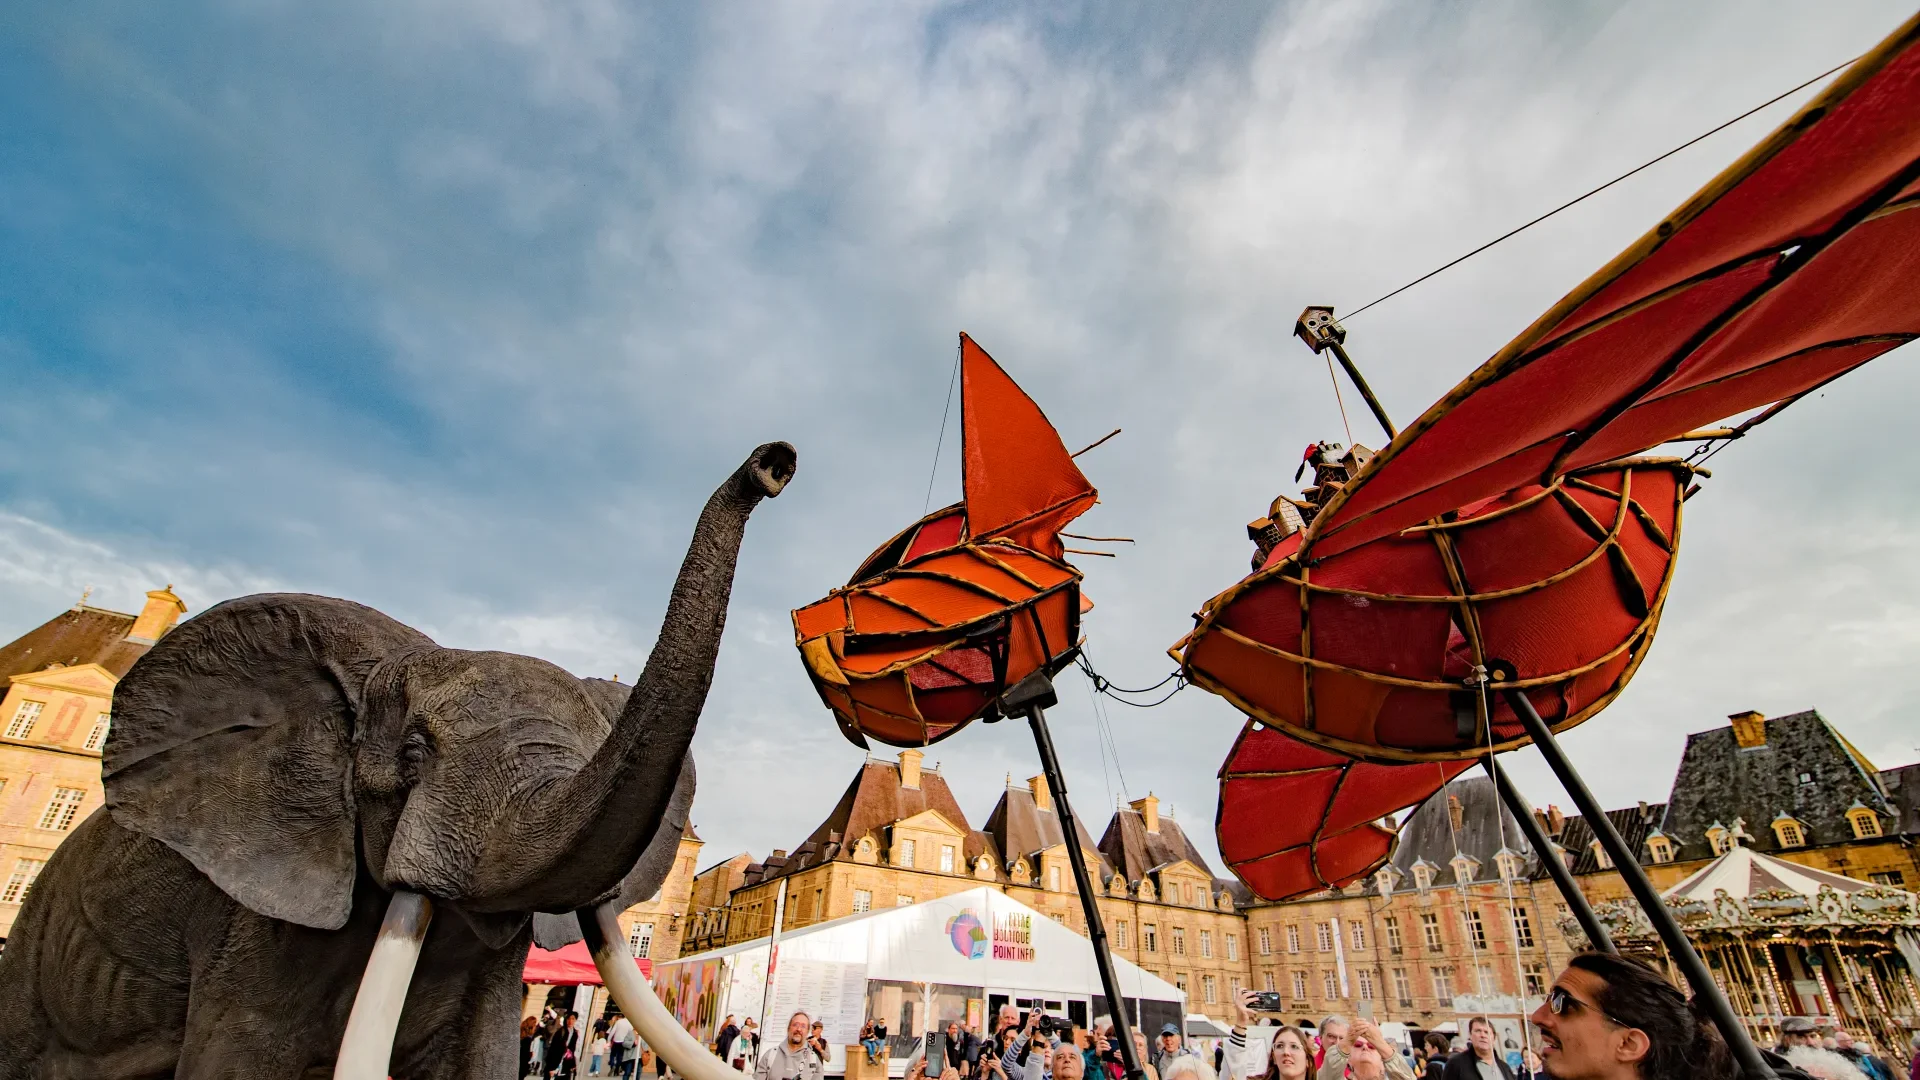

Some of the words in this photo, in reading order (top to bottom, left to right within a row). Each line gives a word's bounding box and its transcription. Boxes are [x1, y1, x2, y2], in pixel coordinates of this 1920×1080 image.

[993, 927, 1030, 944] BOUTIQUE
[993, 945, 1015, 960] POINT
[1017, 947, 1035, 961] INFO
